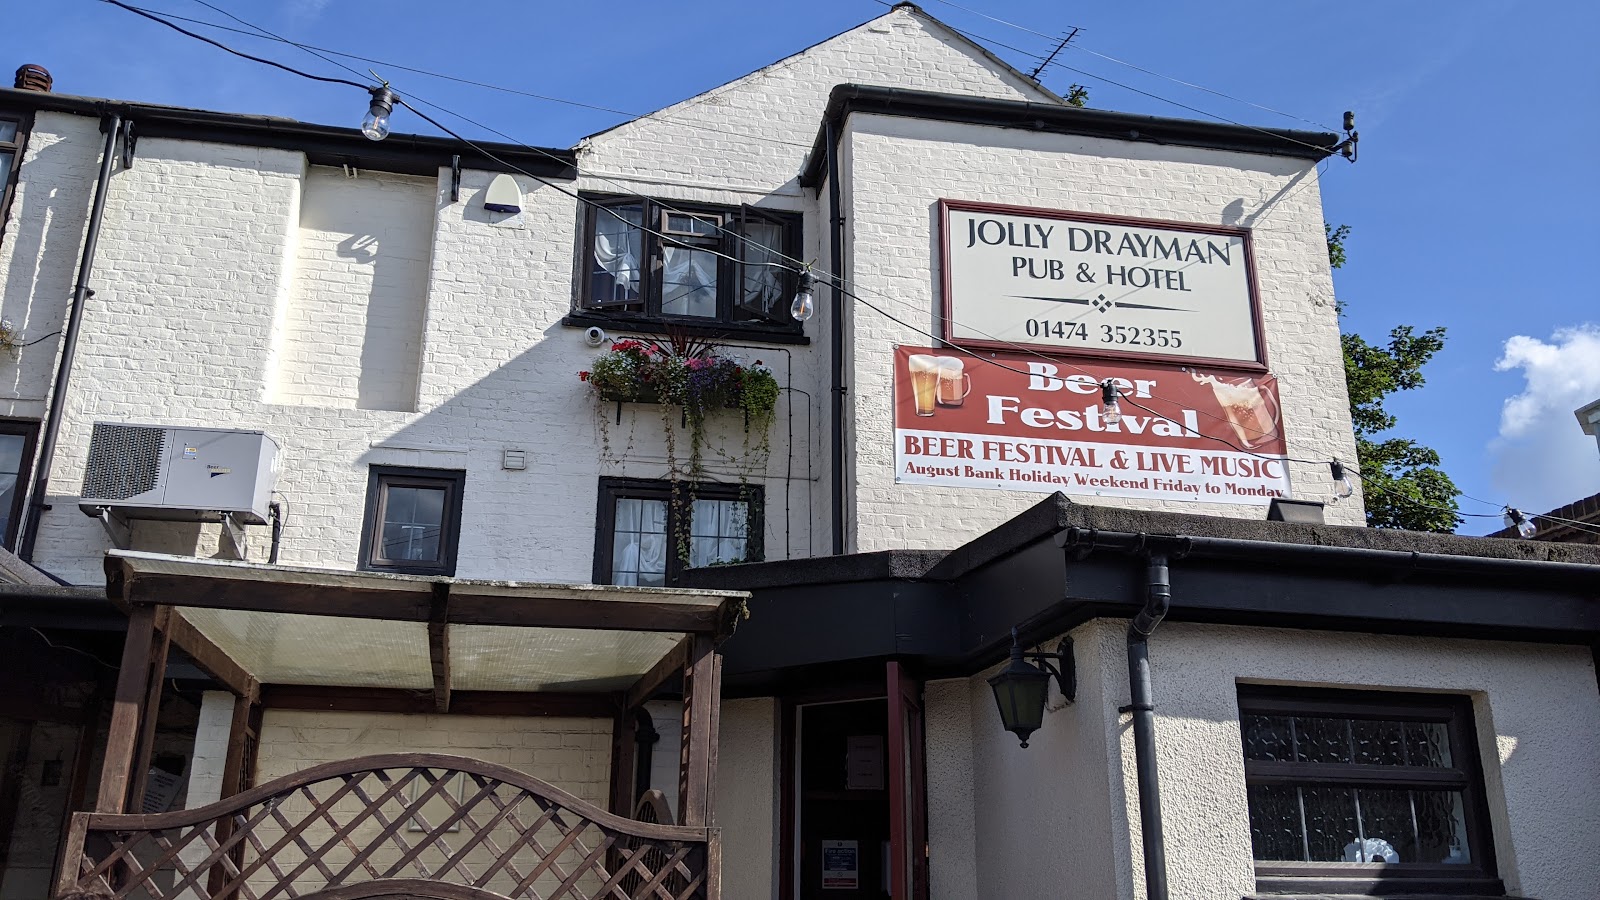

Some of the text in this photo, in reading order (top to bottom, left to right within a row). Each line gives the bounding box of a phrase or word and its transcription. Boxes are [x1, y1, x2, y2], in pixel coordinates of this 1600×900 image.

[967, 218, 1231, 266] JOLLY DRAYMAN
[1012, 256, 1191, 292] PUB & HOTEL
[1026, 318, 1182, 349] 01474 352355
[1027, 361, 1156, 399] Beer
[904, 434, 1283, 480] BEER FESTIVAL & LIVE MUSIC
[904, 461, 1285, 498] August Bank Holiday Weekend Friday to Monday
